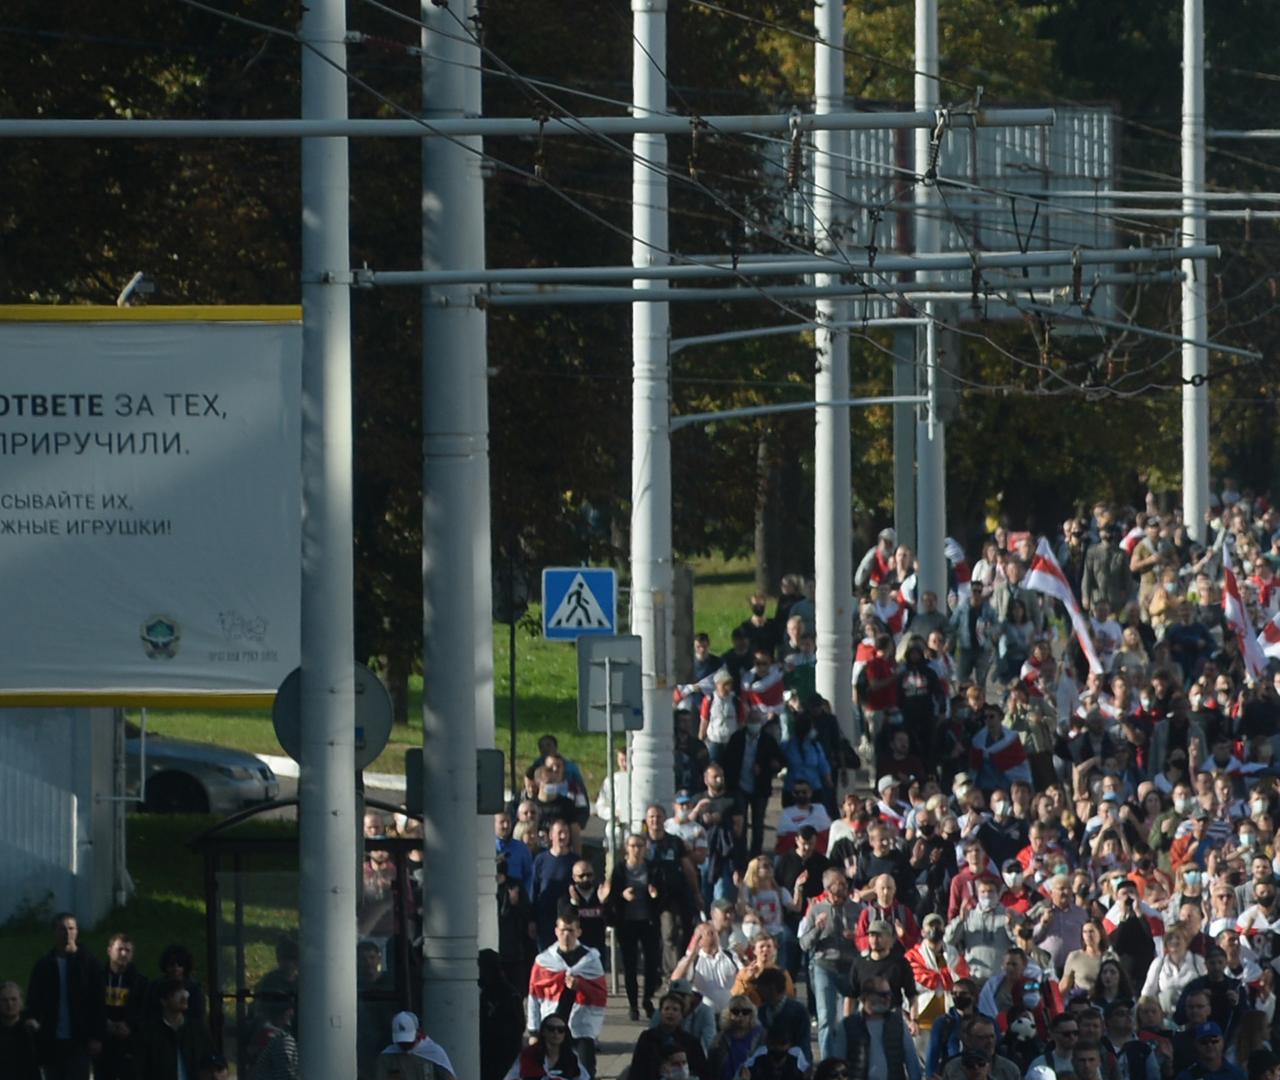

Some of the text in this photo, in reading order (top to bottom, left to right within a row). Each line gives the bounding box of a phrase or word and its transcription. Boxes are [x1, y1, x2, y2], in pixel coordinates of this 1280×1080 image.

[115, 393, 154, 416] ЗА
[163, 394, 228, 419] ТЕХ,
[66, 519, 172, 536] ИГРУШКИ!
